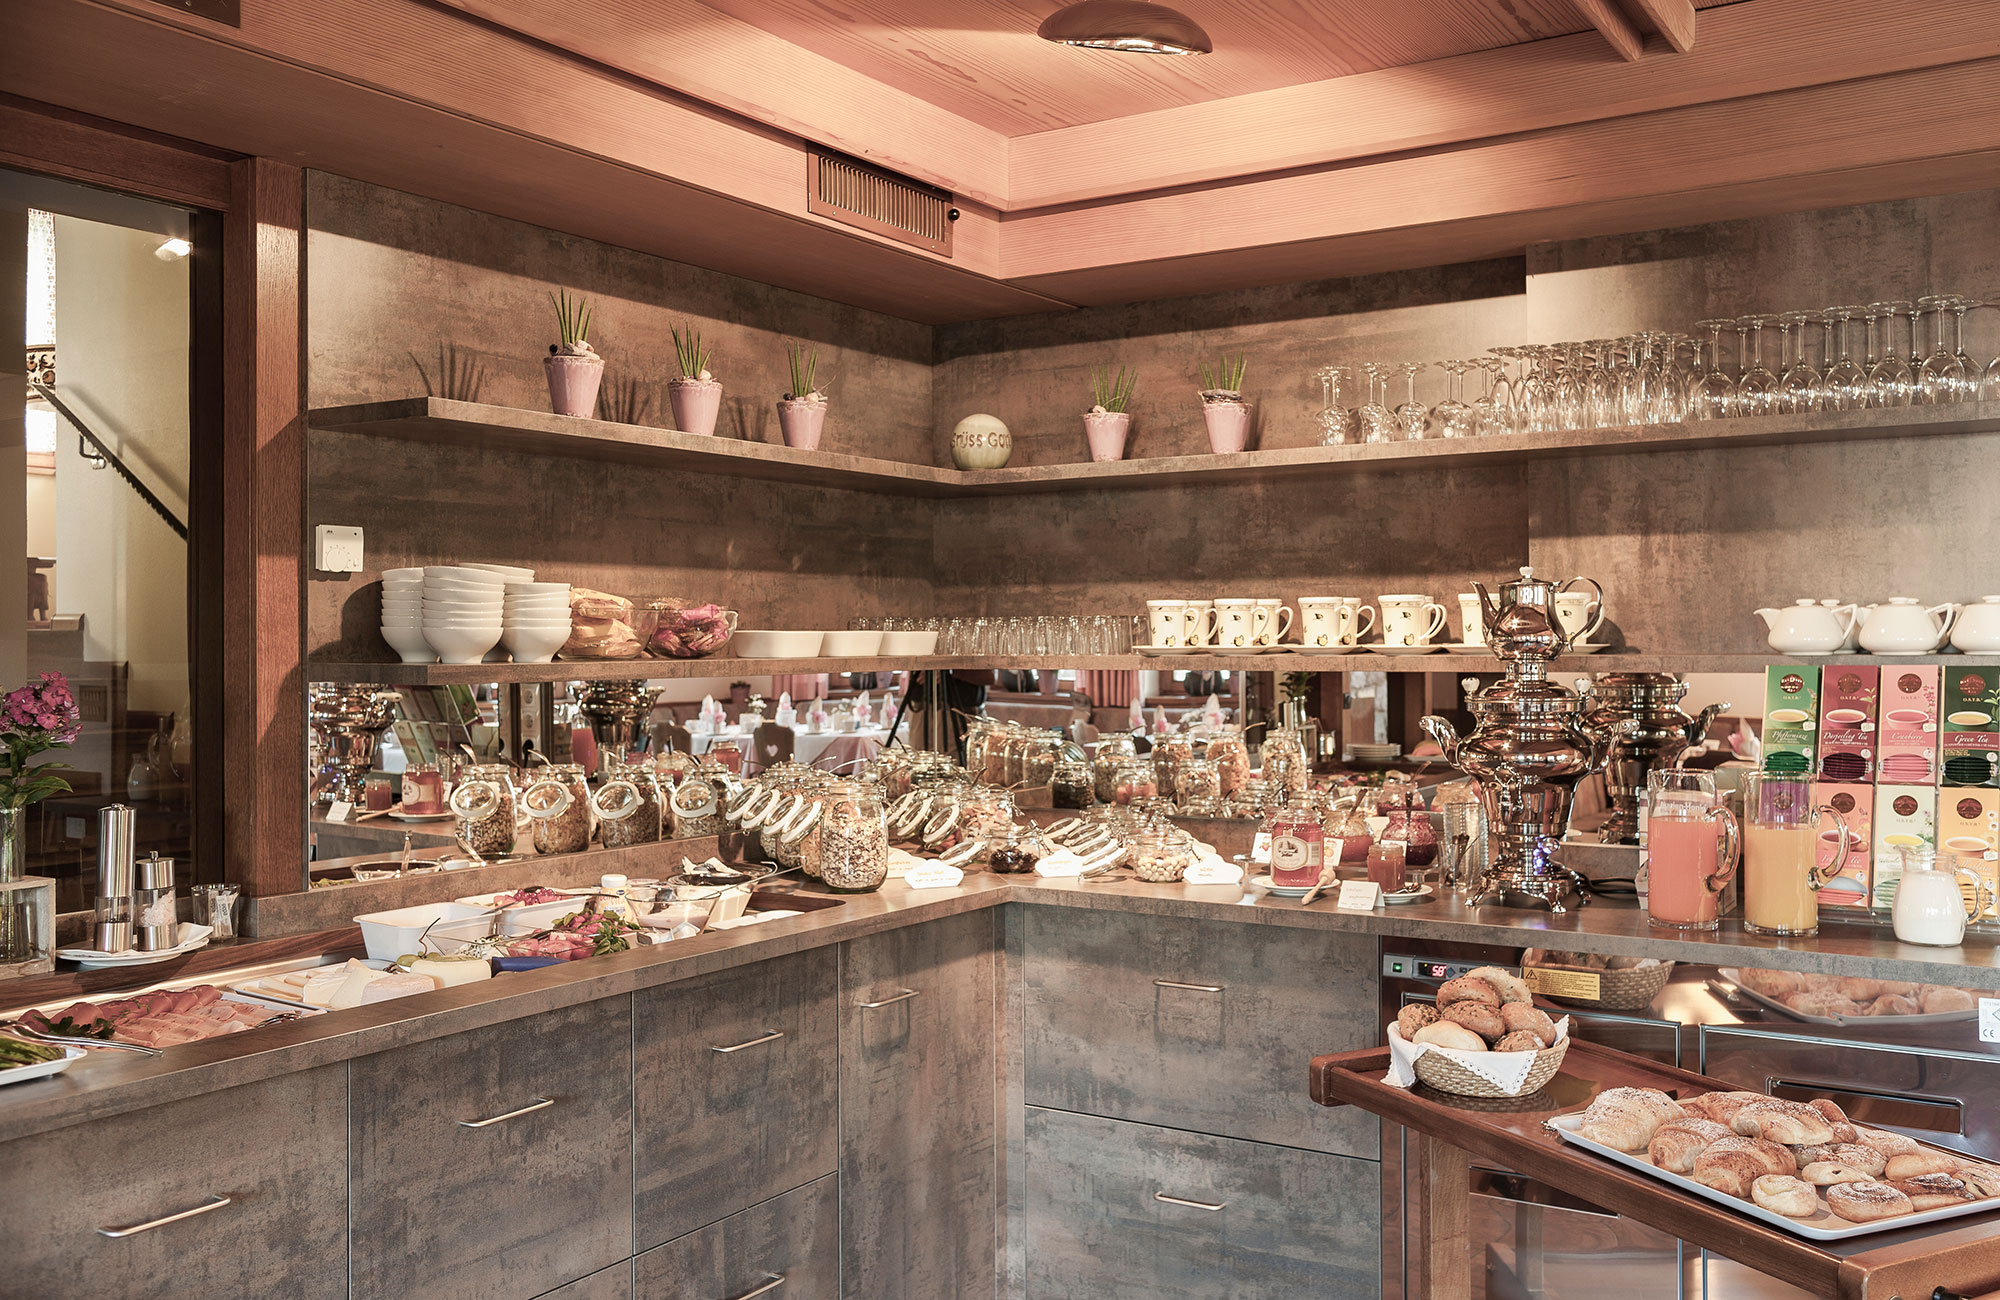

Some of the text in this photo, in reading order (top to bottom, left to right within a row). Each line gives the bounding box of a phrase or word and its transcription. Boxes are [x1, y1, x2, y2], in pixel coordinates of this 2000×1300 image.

[1857, 732, 1868, 740] Tea
[1954, 734, 1989, 745] Green Tea
